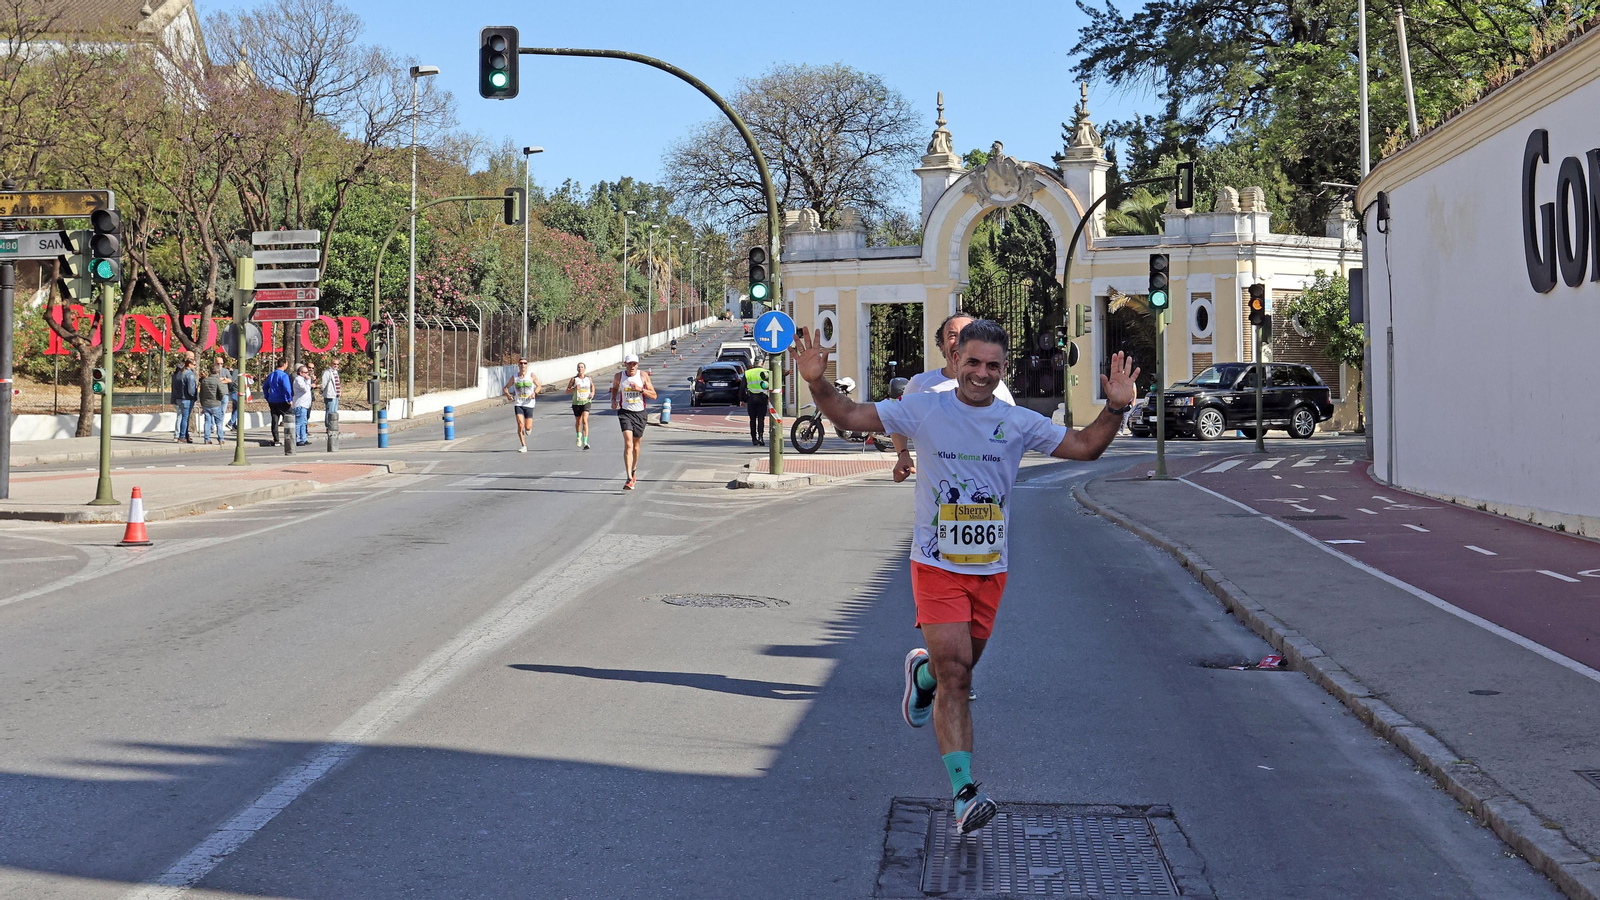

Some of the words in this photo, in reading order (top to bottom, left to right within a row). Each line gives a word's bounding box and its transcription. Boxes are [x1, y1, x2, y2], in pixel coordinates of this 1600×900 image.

[12, 204, 45, 214] Artes
[43, 304, 369, 355] FUNDOR
[938, 451, 956, 459] Klub
[982, 454, 1001, 462] Kilos
[958, 505, 989, 517] Sherry
[950, 524, 996, 545] 1686
